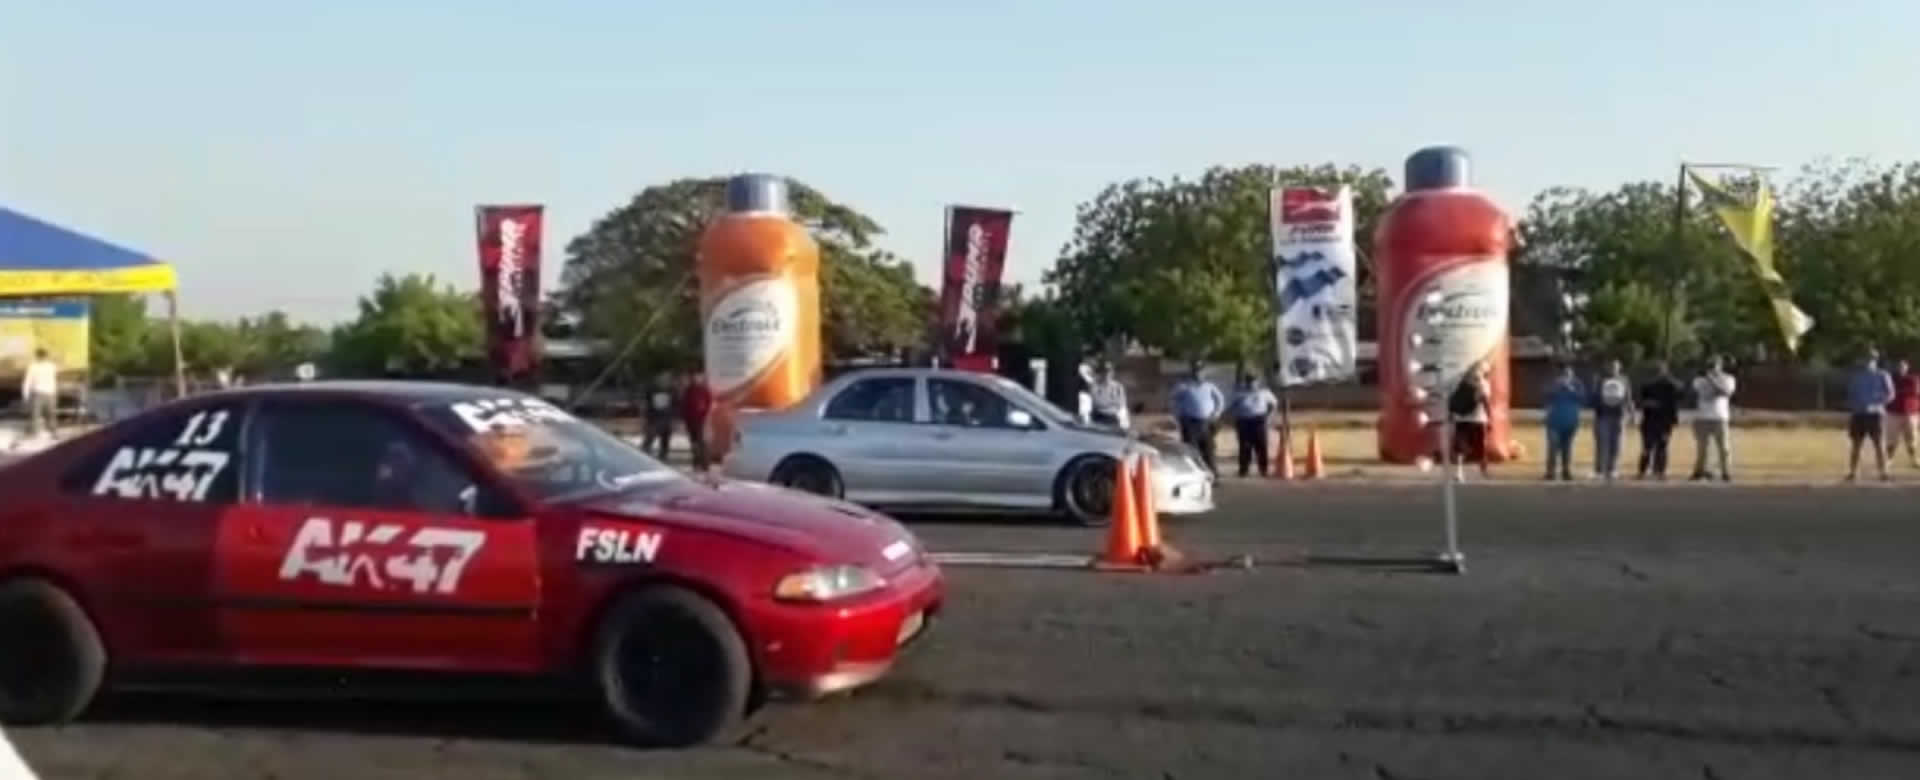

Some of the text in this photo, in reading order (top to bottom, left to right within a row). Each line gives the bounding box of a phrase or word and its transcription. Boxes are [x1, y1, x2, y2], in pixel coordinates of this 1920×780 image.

[176, 411, 227, 445] 13
[93, 446, 229, 500] AK47
[279, 516, 486, 594] AK47
[576, 527, 661, 563] FSLN
